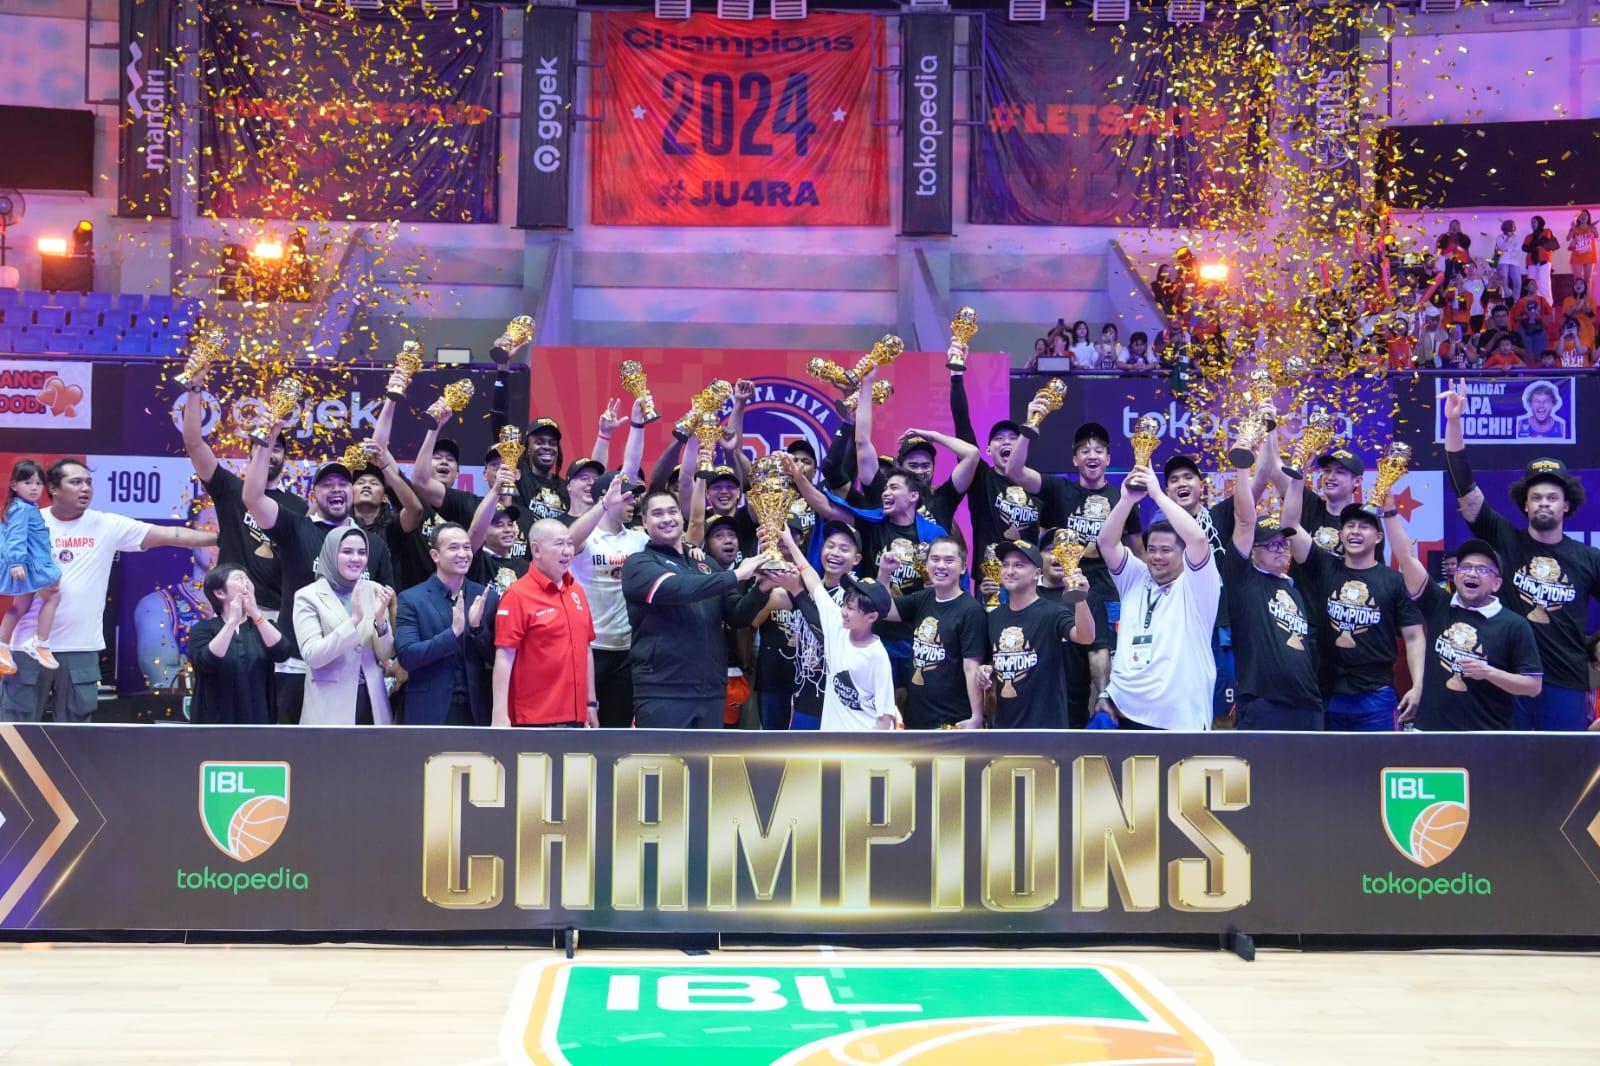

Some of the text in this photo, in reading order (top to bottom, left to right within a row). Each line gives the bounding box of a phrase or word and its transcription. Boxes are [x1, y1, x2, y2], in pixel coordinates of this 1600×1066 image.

[623, 26, 855, 59] Champions
[536, 56, 562, 140] gojek
[141, 69, 165, 170] mandiri
[661, 71, 816, 157] 2024
[913, 55, 943, 196] tokopedia
[657, 179, 820, 208] #JU4RA
[785, 388, 830, 424] JAYA
[1460, 417, 1513, 436] OCHI!
[108, 470, 160, 503] 1990
[55, 537, 95, 548] CHAMPS
[592, 554, 607, 566] IBL
[1513, 572, 1576, 602] CHAMPIONS
[1225, 688, 1234, 703] 9
[209, 771, 256, 793] IBL
[1391, 777, 1435, 799] IBL
[422, 751, 1252, 913] CHAMPIONS
[177, 866, 308, 895] tokopedia
[1362, 871, 1491, 900] tokopedia
[606, 975, 923, 1012] IBL
